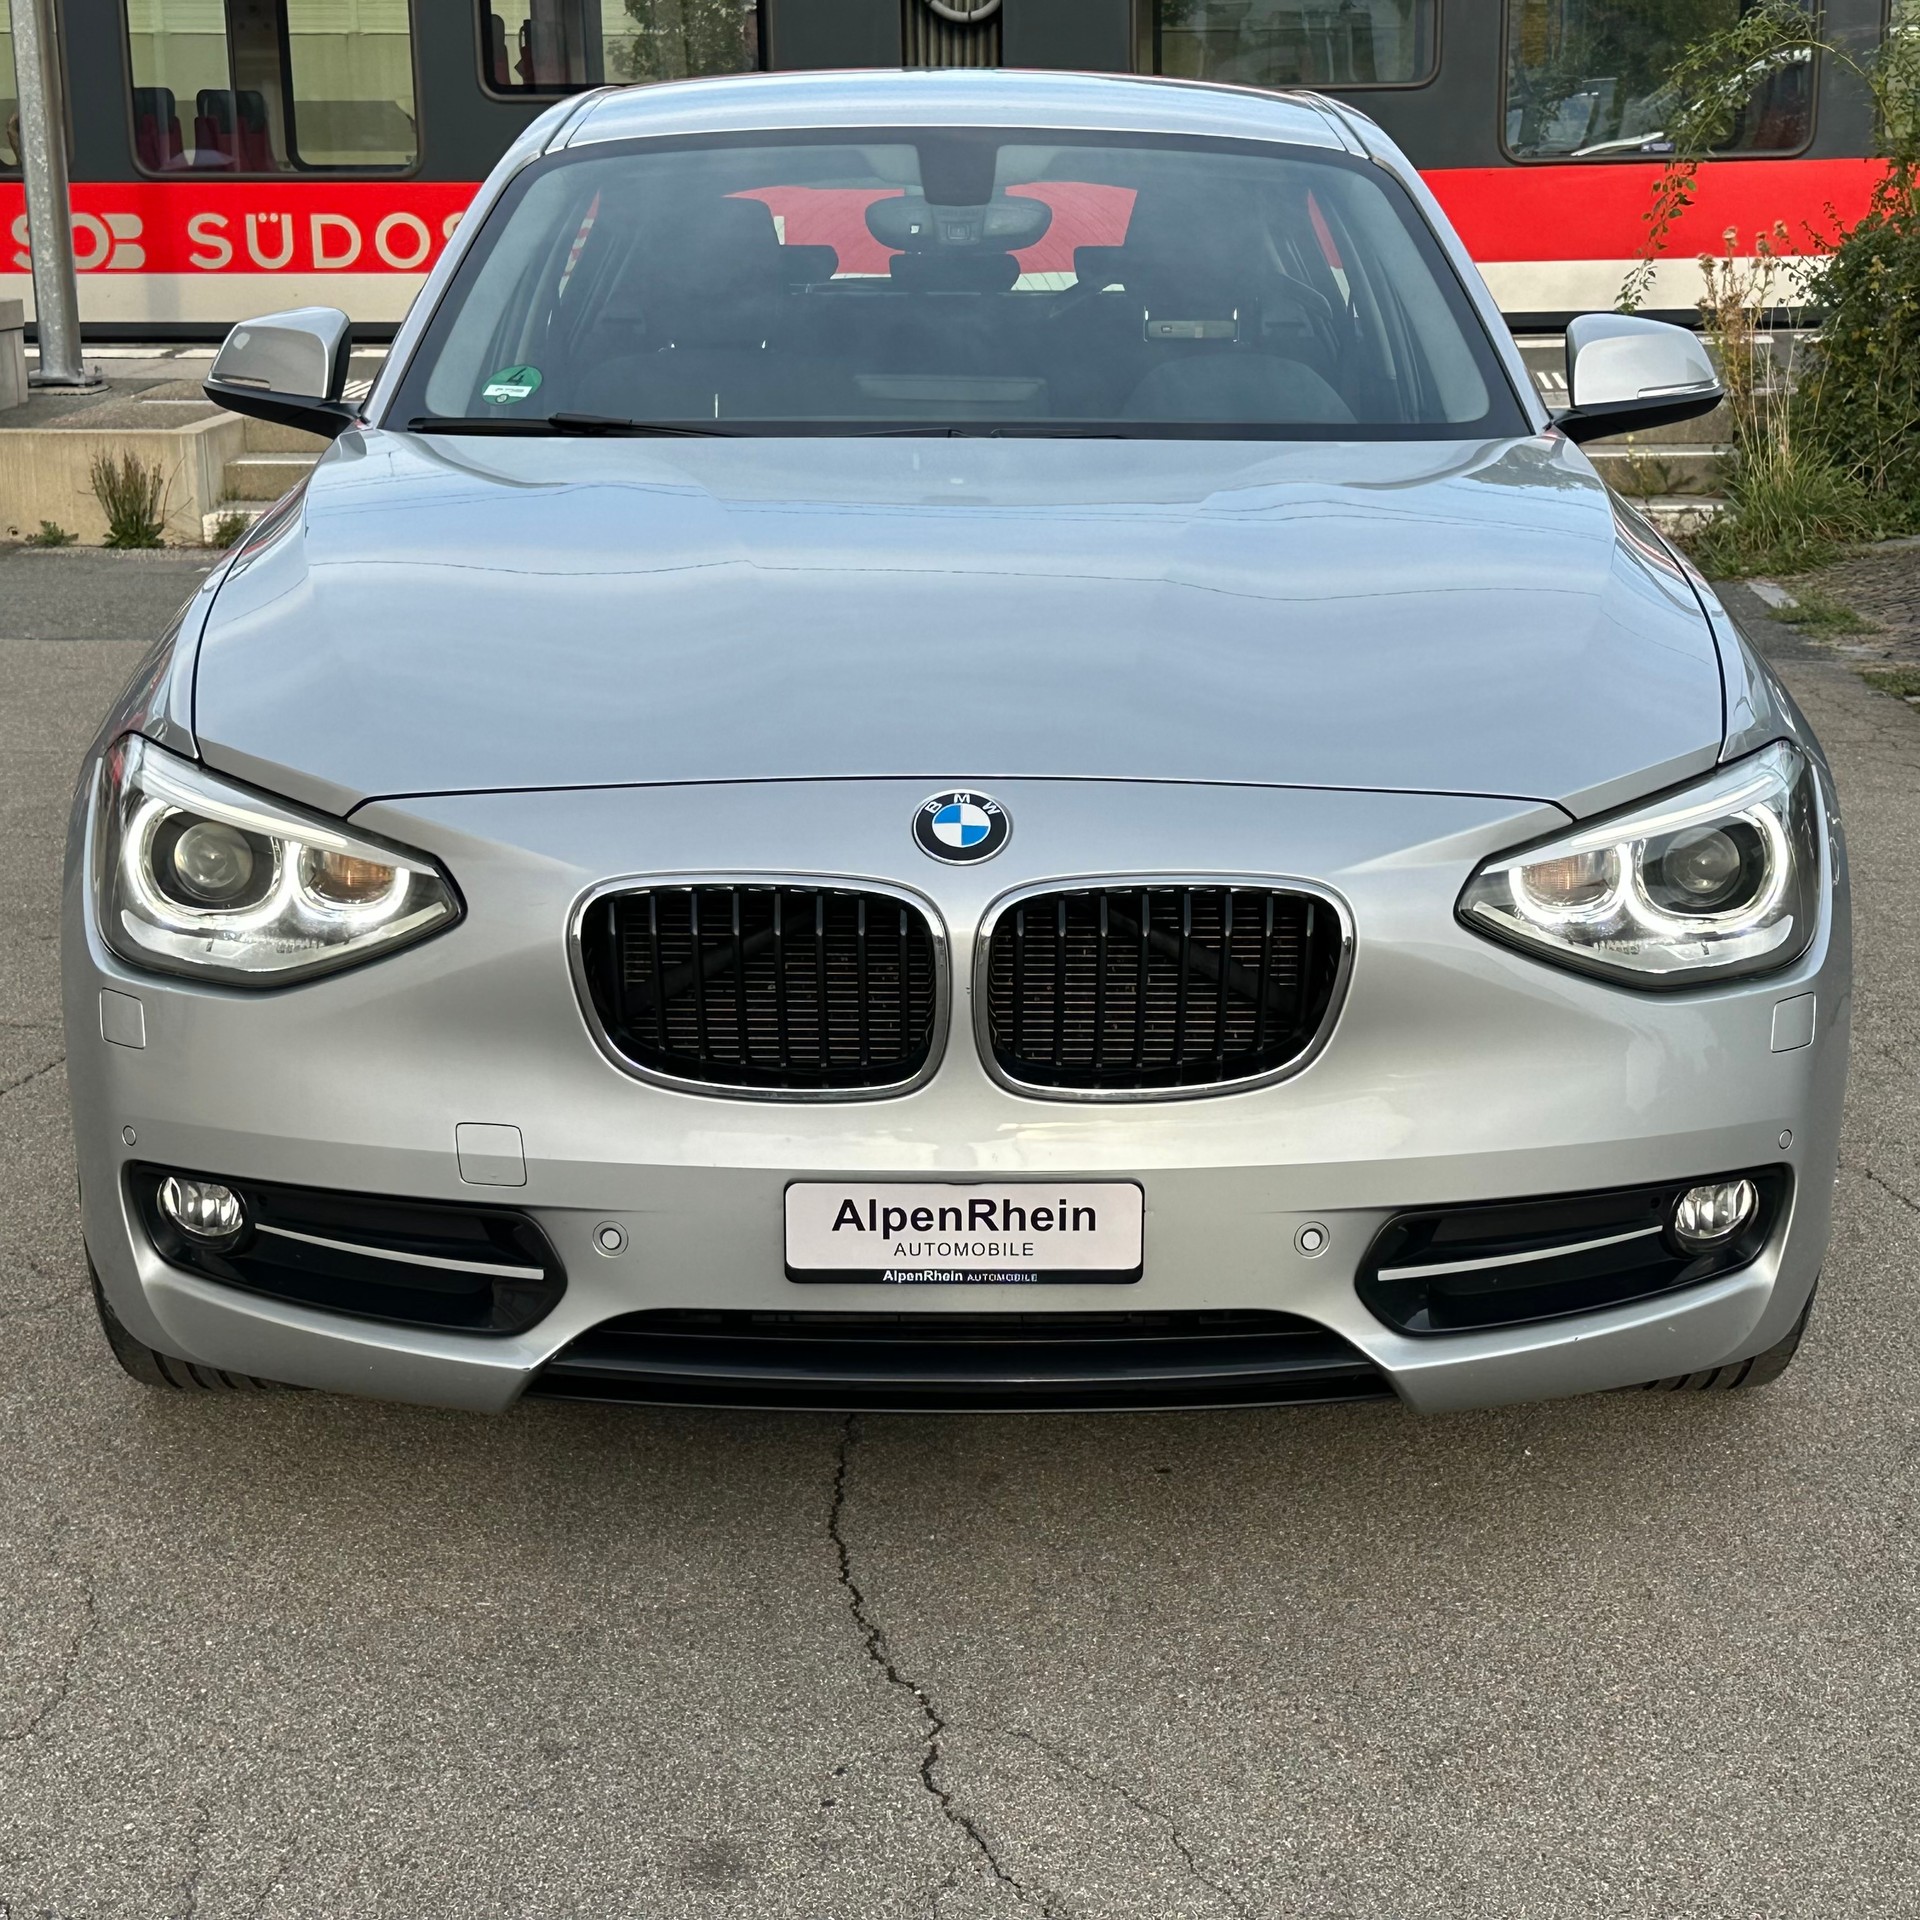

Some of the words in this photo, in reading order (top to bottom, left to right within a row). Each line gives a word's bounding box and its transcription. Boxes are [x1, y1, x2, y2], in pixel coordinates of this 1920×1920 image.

[924, 793, 1001, 815] BMW
[832, 1198, 1096, 1240] AlpenRhein
[893, 1242, 1034, 1257] AUTOMOBILE
[882, 1269, 964, 1284] AlpenRhein
